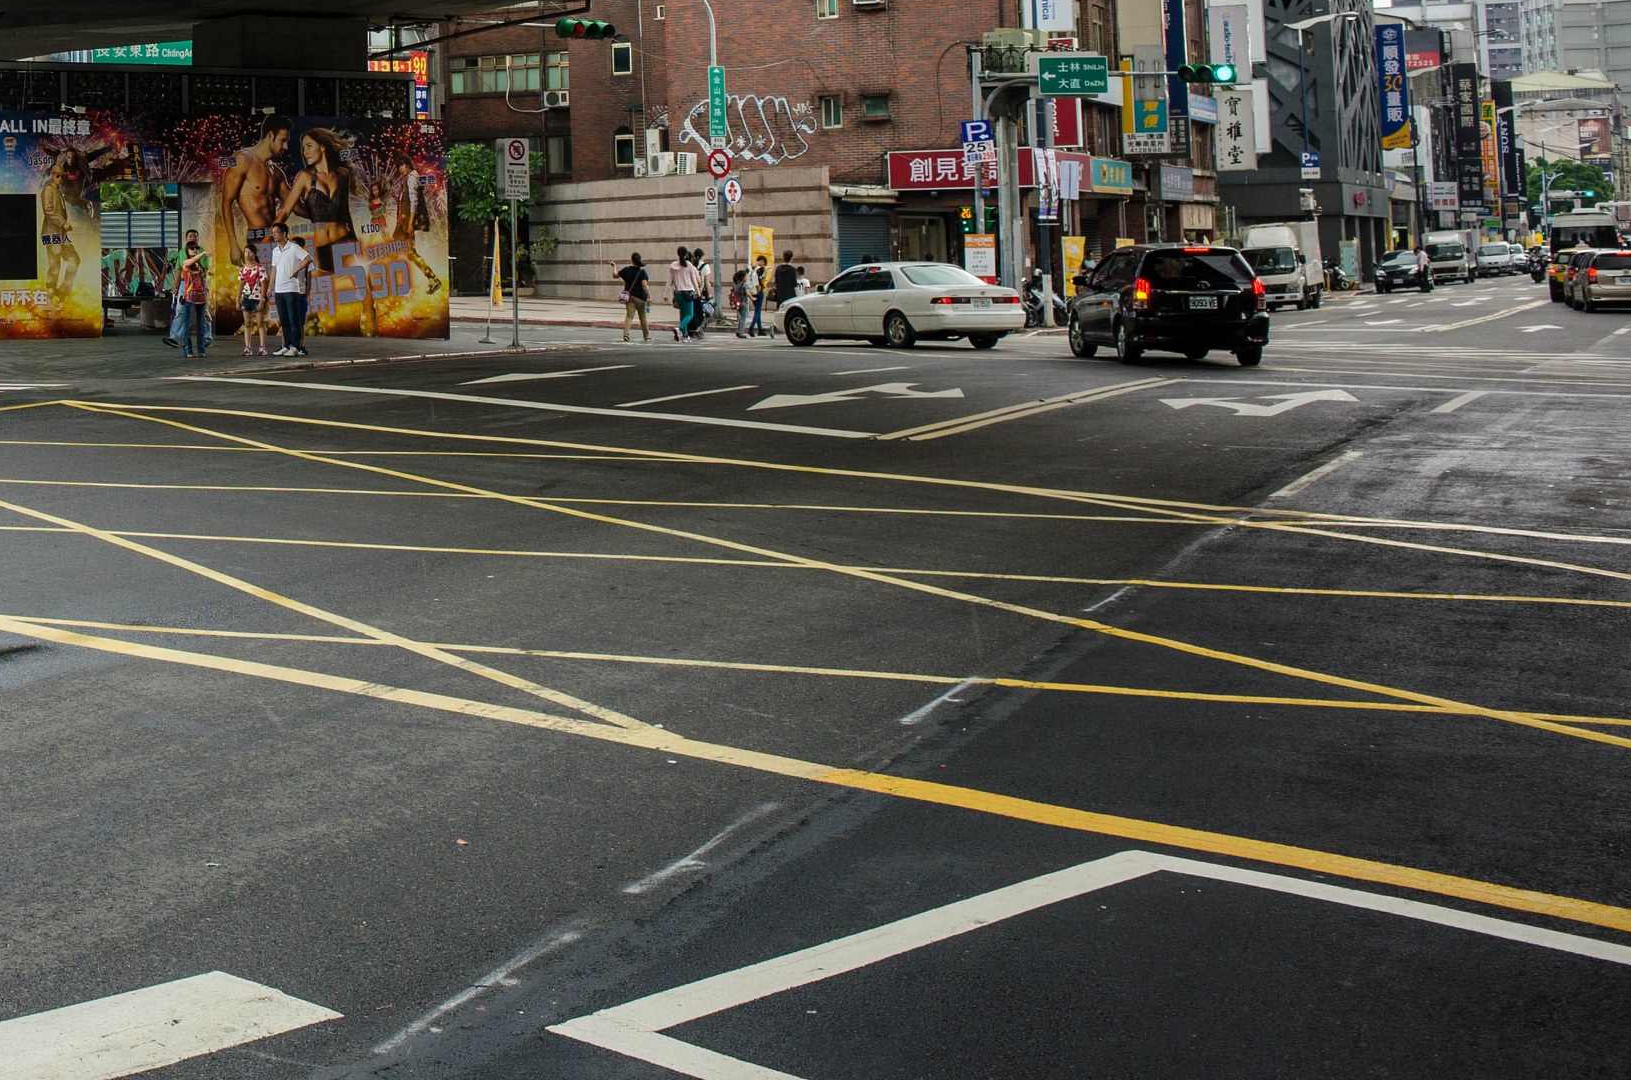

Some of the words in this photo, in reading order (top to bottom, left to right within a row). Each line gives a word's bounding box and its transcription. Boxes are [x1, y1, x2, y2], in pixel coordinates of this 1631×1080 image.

[1058, 62, 1080, 73] 士林
[1058, 78, 1081, 89] 大直
[966, 122, 987, 141] P
[966, 143, 986, 153] 25
[28, 155, 55, 166] Jason
[1302, 153, 1310, 163] P
